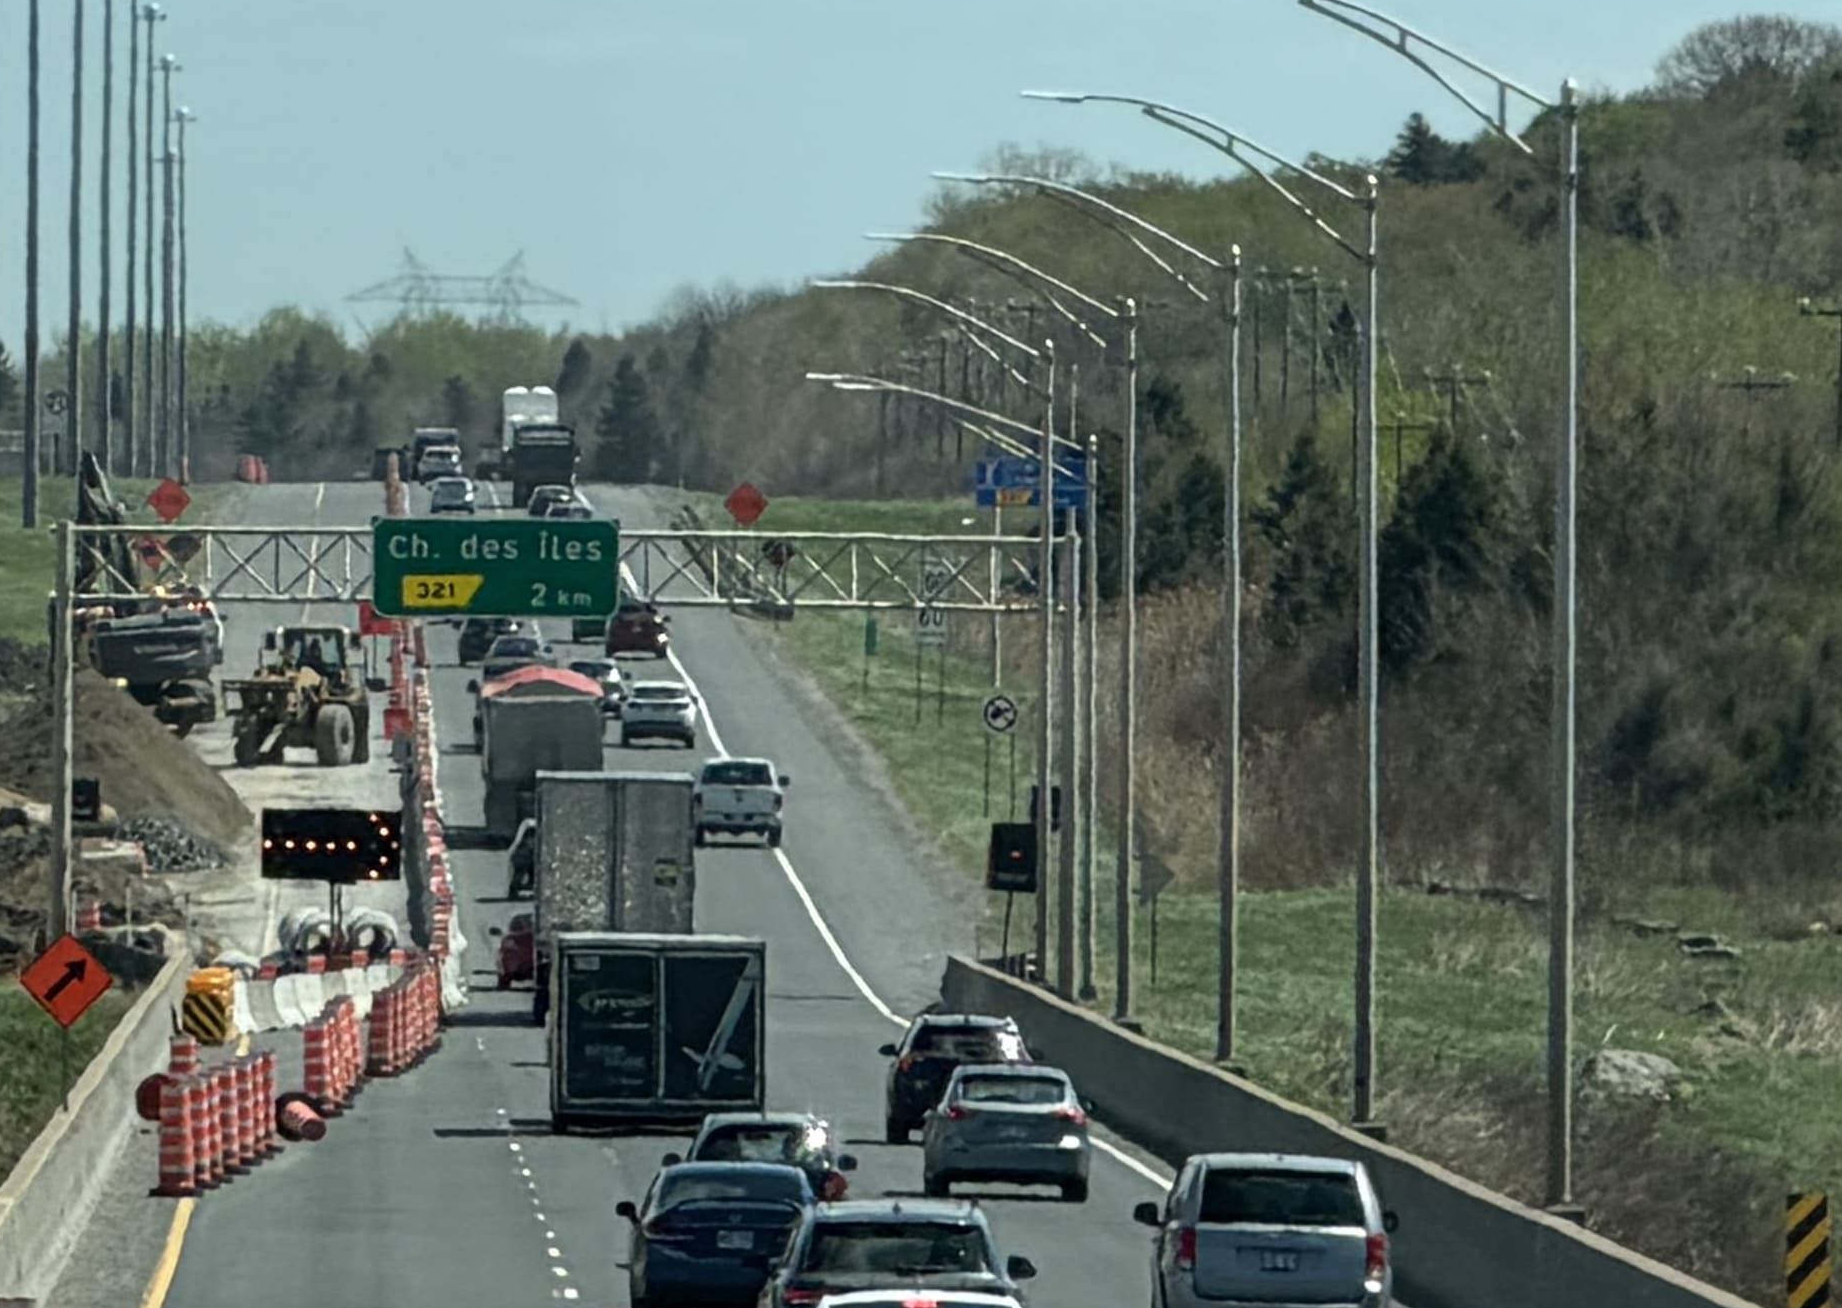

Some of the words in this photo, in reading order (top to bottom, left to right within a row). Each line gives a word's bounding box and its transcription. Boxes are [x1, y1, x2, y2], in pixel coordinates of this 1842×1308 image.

[388, 534, 440, 559] Ch.
[460, 534, 519, 560] des
[538, 530, 603, 561] Îles
[416, 582, 456, 599] 321
[530, 582, 547, 607] 2
[557, 588, 592, 607] km
